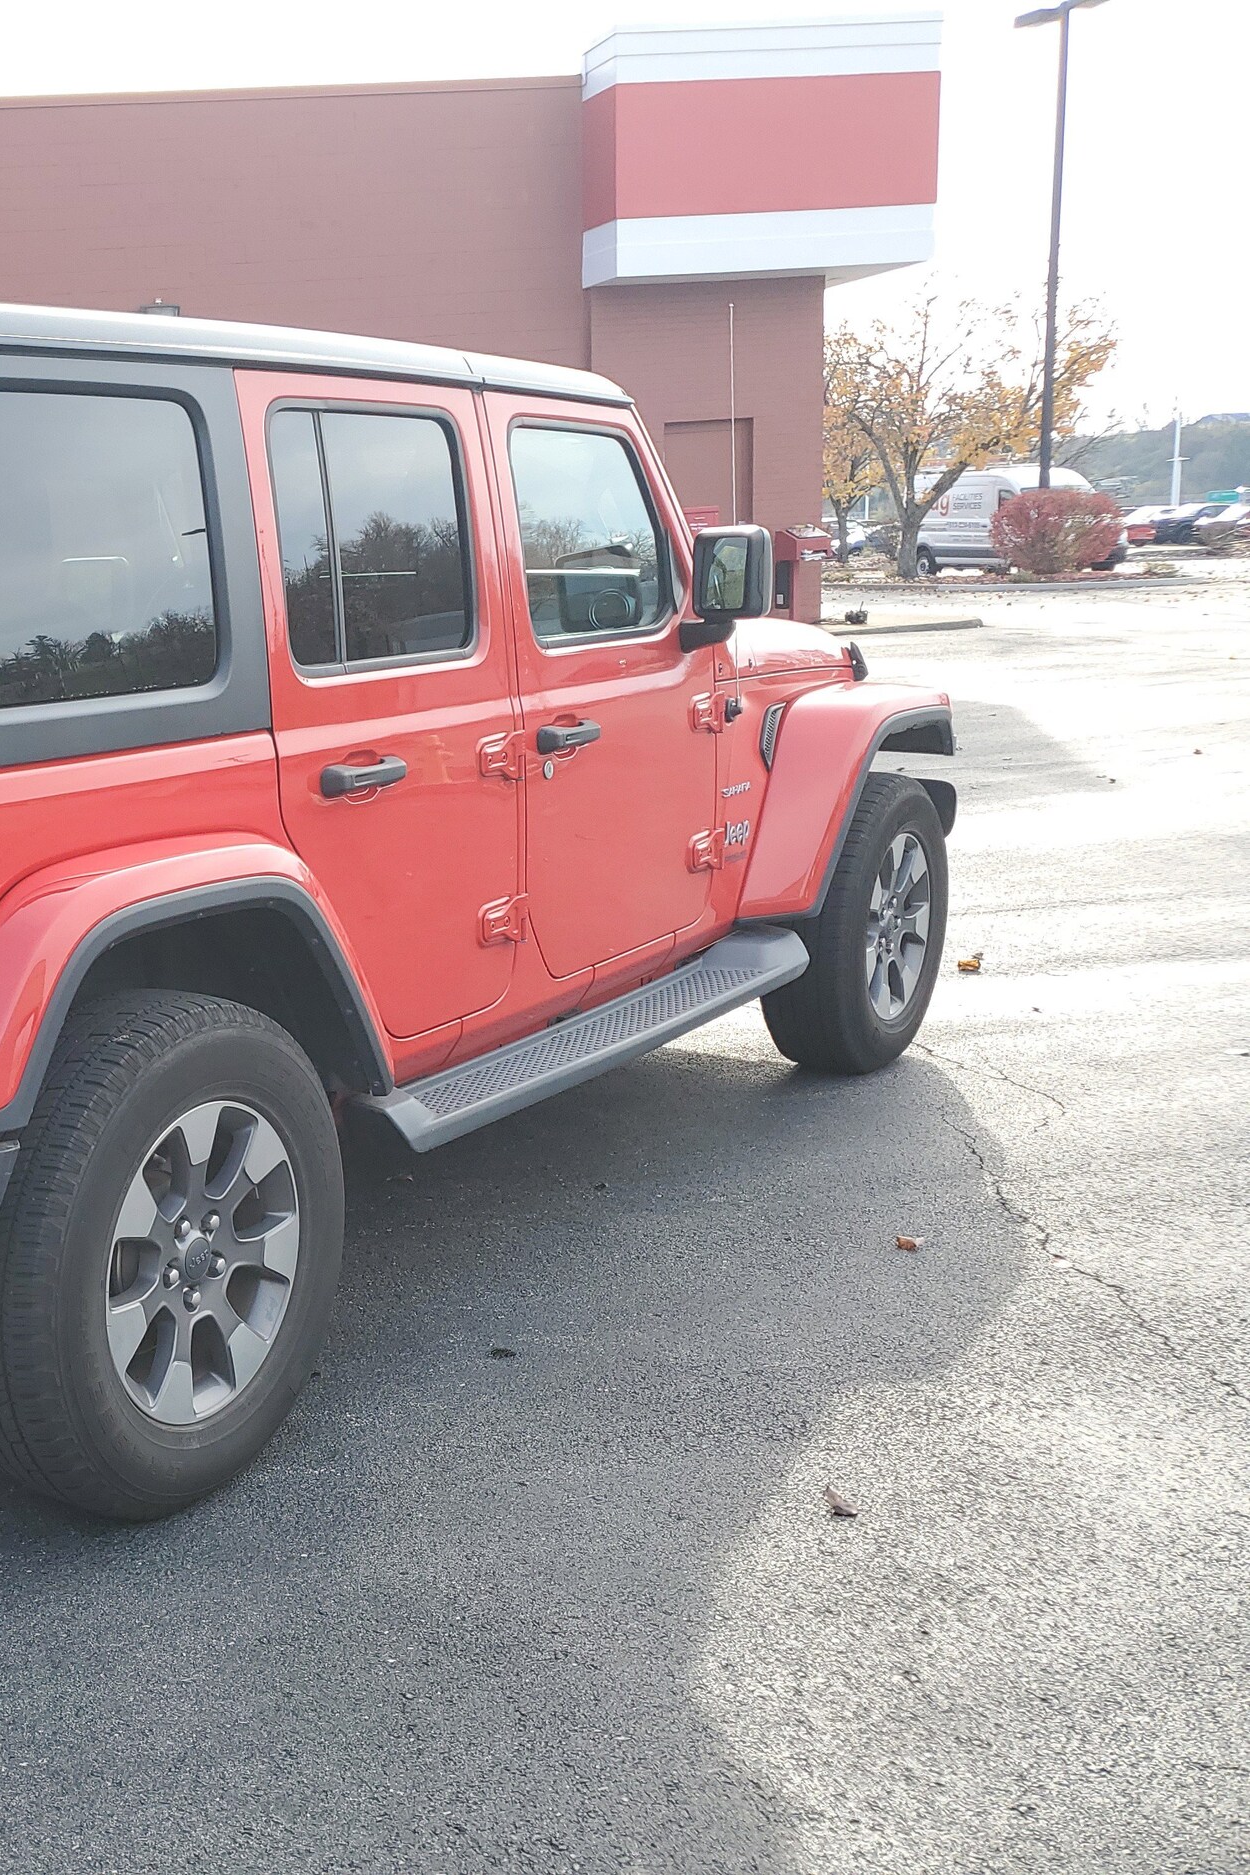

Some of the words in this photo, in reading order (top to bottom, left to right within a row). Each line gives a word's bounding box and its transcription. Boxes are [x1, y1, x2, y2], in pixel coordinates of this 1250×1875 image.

[953, 493, 983, 501] FACILITIES
[953, 502, 982, 510] SERVICES
[724, 819, 750, 848] Jeep
